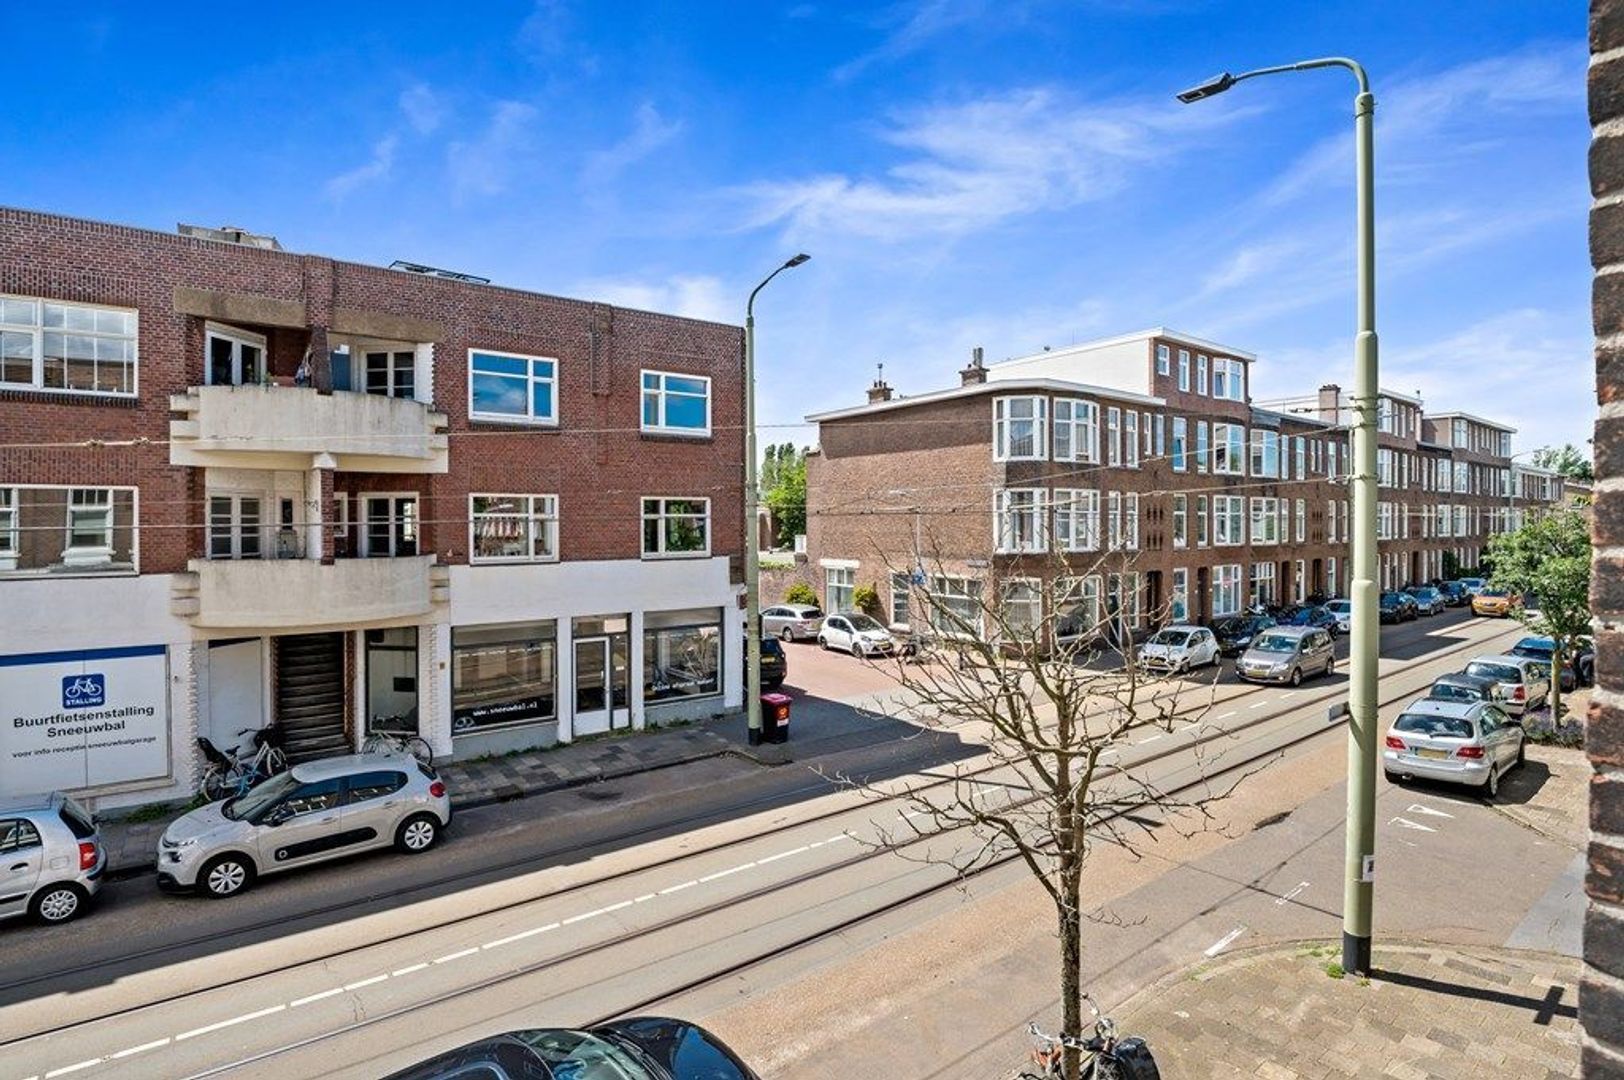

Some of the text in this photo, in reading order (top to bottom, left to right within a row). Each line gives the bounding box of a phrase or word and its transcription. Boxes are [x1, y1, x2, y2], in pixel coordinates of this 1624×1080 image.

[65, 697, 103, 706] STALLING
[13, 706, 155, 728] Buurtfietsenstalling
[47, 720, 126, 738] Sneeuwbal
[12, 750, 33, 758] voor
[34, 747, 51, 756] info
